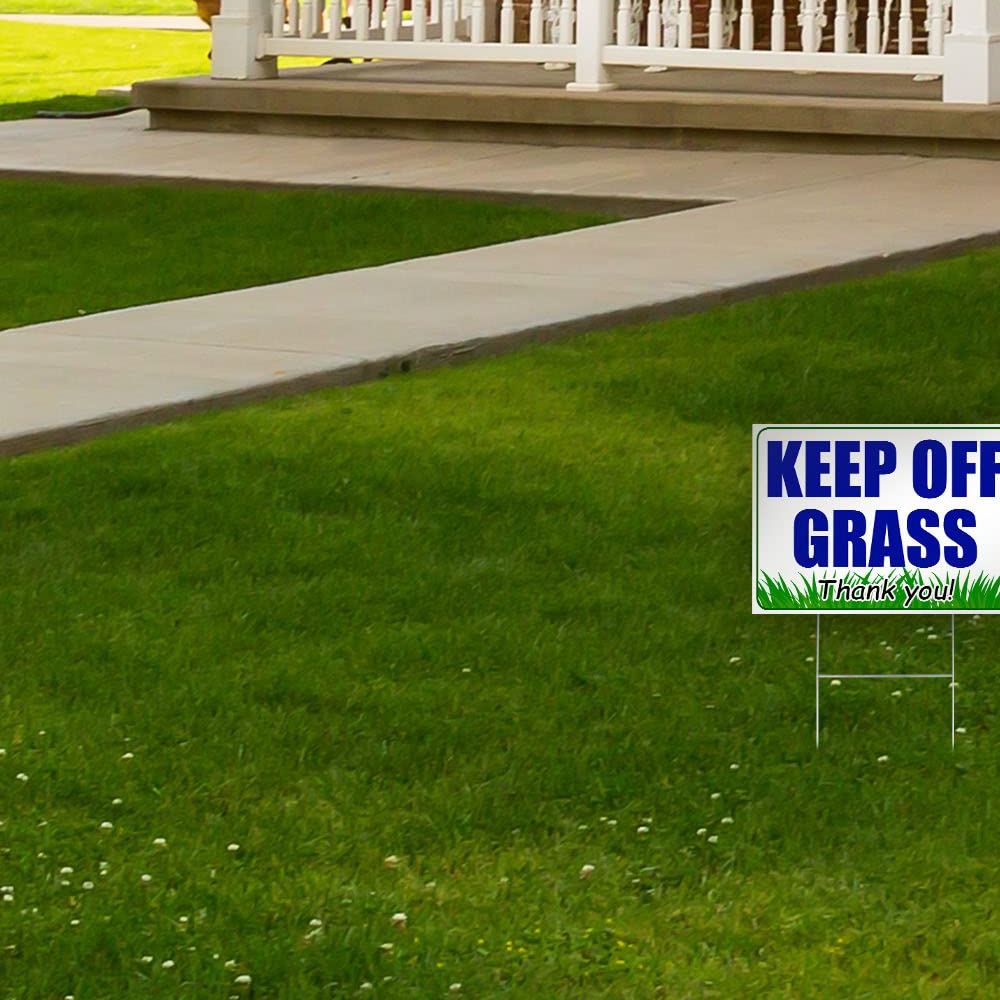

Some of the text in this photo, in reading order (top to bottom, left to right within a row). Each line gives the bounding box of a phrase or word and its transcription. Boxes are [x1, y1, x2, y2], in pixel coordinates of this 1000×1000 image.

[767, 440, 897, 497] KEEP
[793, 508, 978, 568] GRASS
[818, 578, 955, 607] Thank you!
